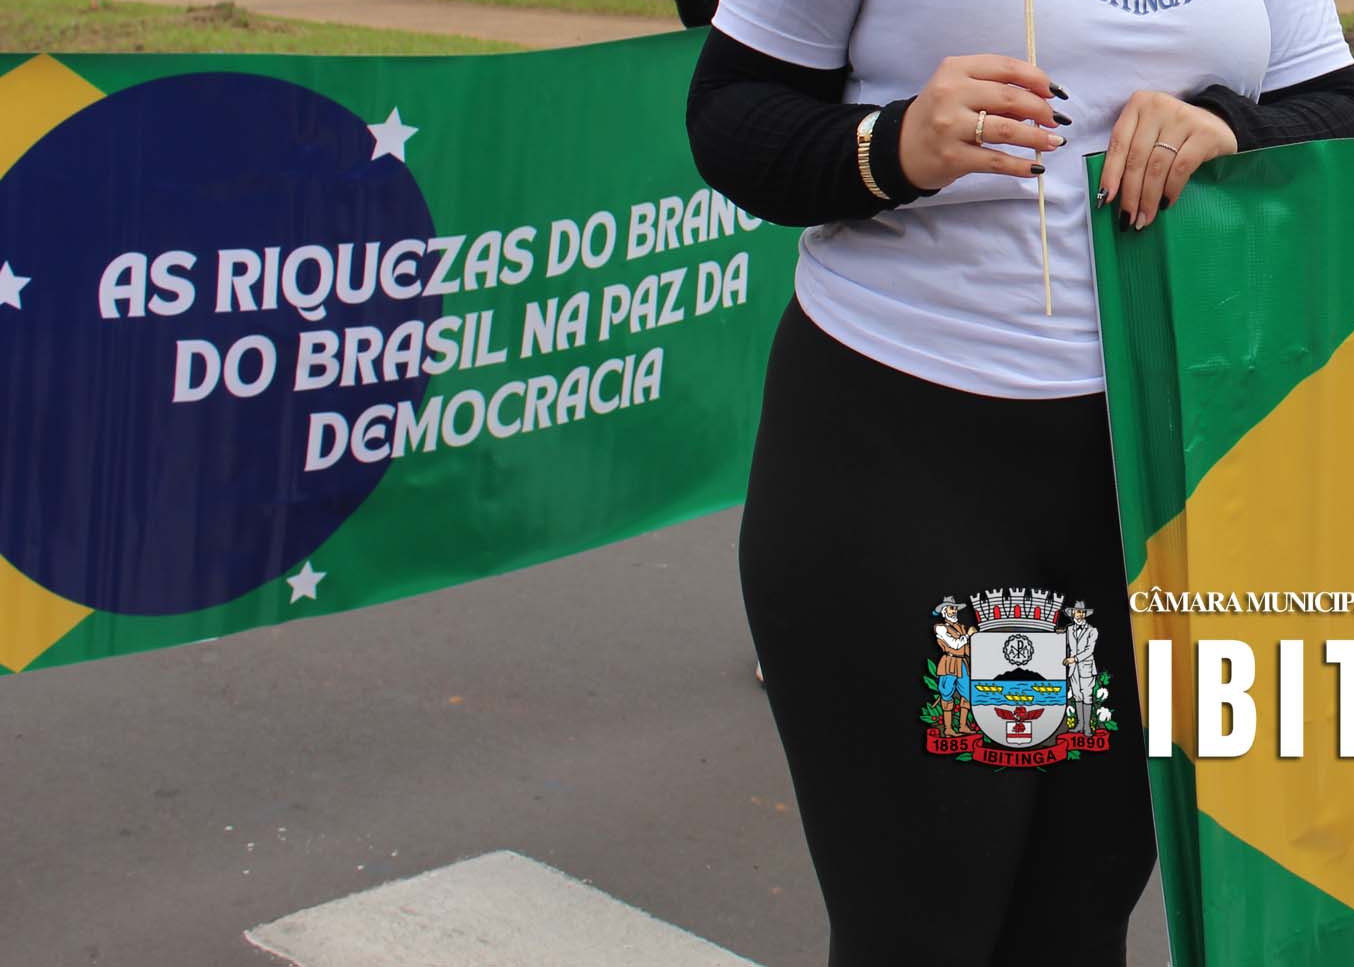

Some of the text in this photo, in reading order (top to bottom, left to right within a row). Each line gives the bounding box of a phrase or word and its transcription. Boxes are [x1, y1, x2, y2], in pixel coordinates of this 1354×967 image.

[99, 188, 775, 321] AS RIQUEZAS DO BRAN
[173, 251, 749, 403] DO BRASIL NA PAZ DA
[304, 347, 664, 472] DEMOCRACIA
